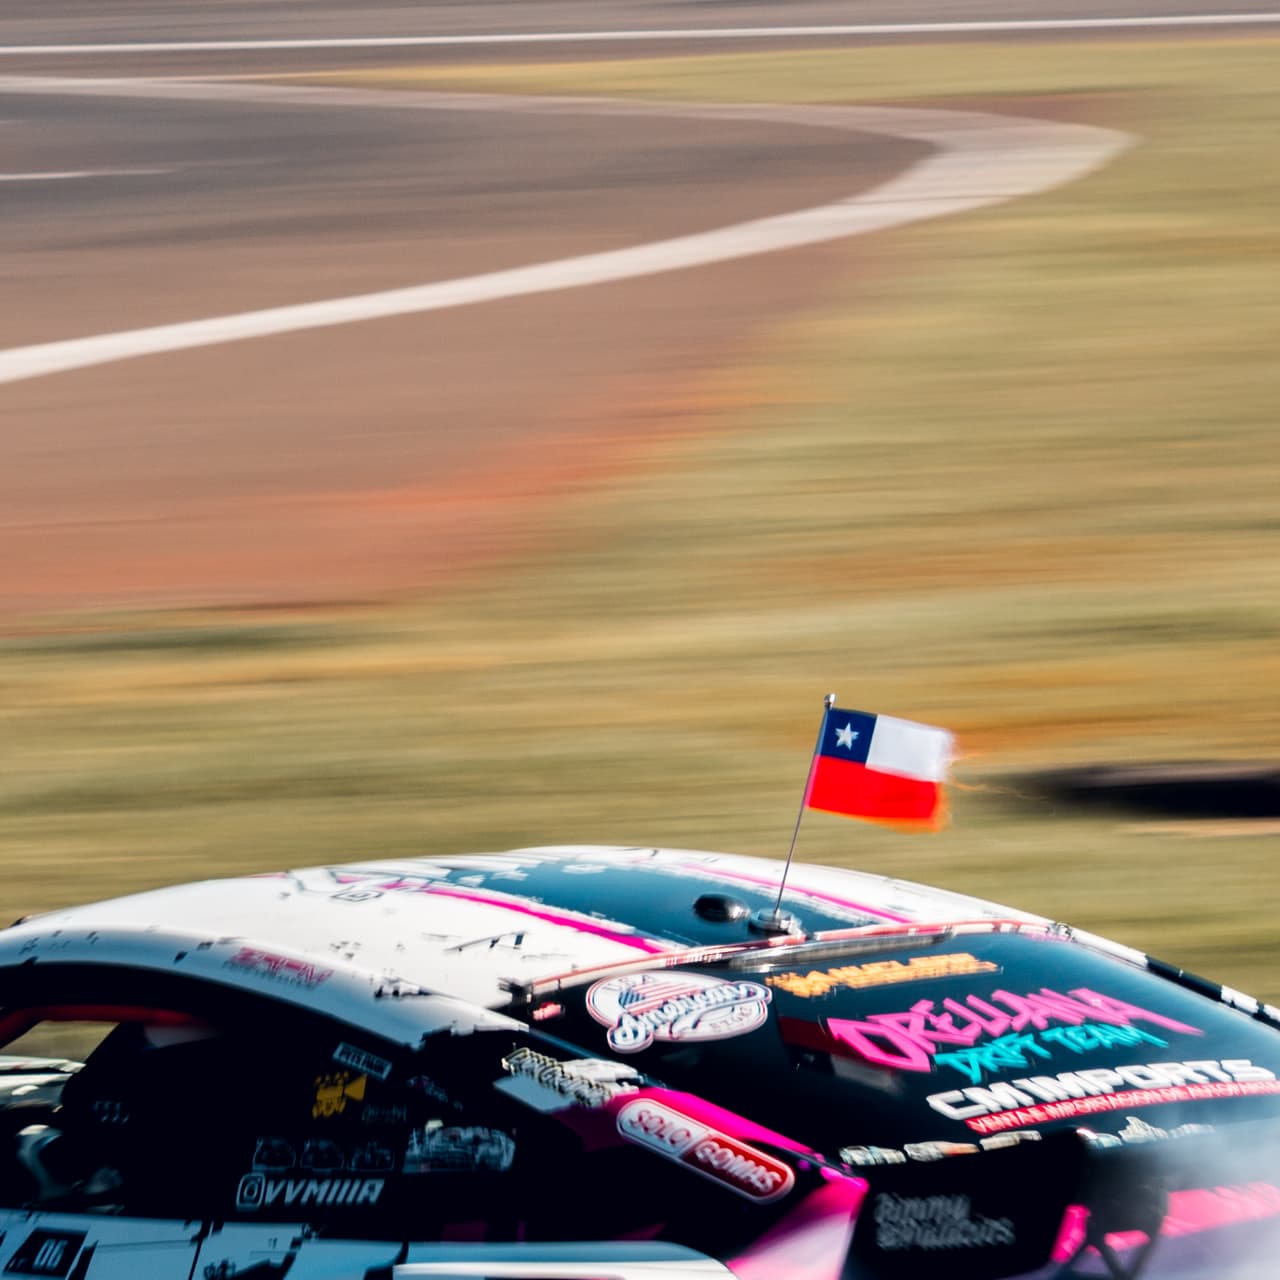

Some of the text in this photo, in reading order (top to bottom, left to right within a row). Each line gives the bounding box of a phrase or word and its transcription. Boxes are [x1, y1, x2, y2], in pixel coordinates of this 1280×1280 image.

[1050, 1023, 1169, 1058] TEAM
[630, 1109, 692, 1147] SOLO
[696, 1140, 784, 1194] GOMAS
